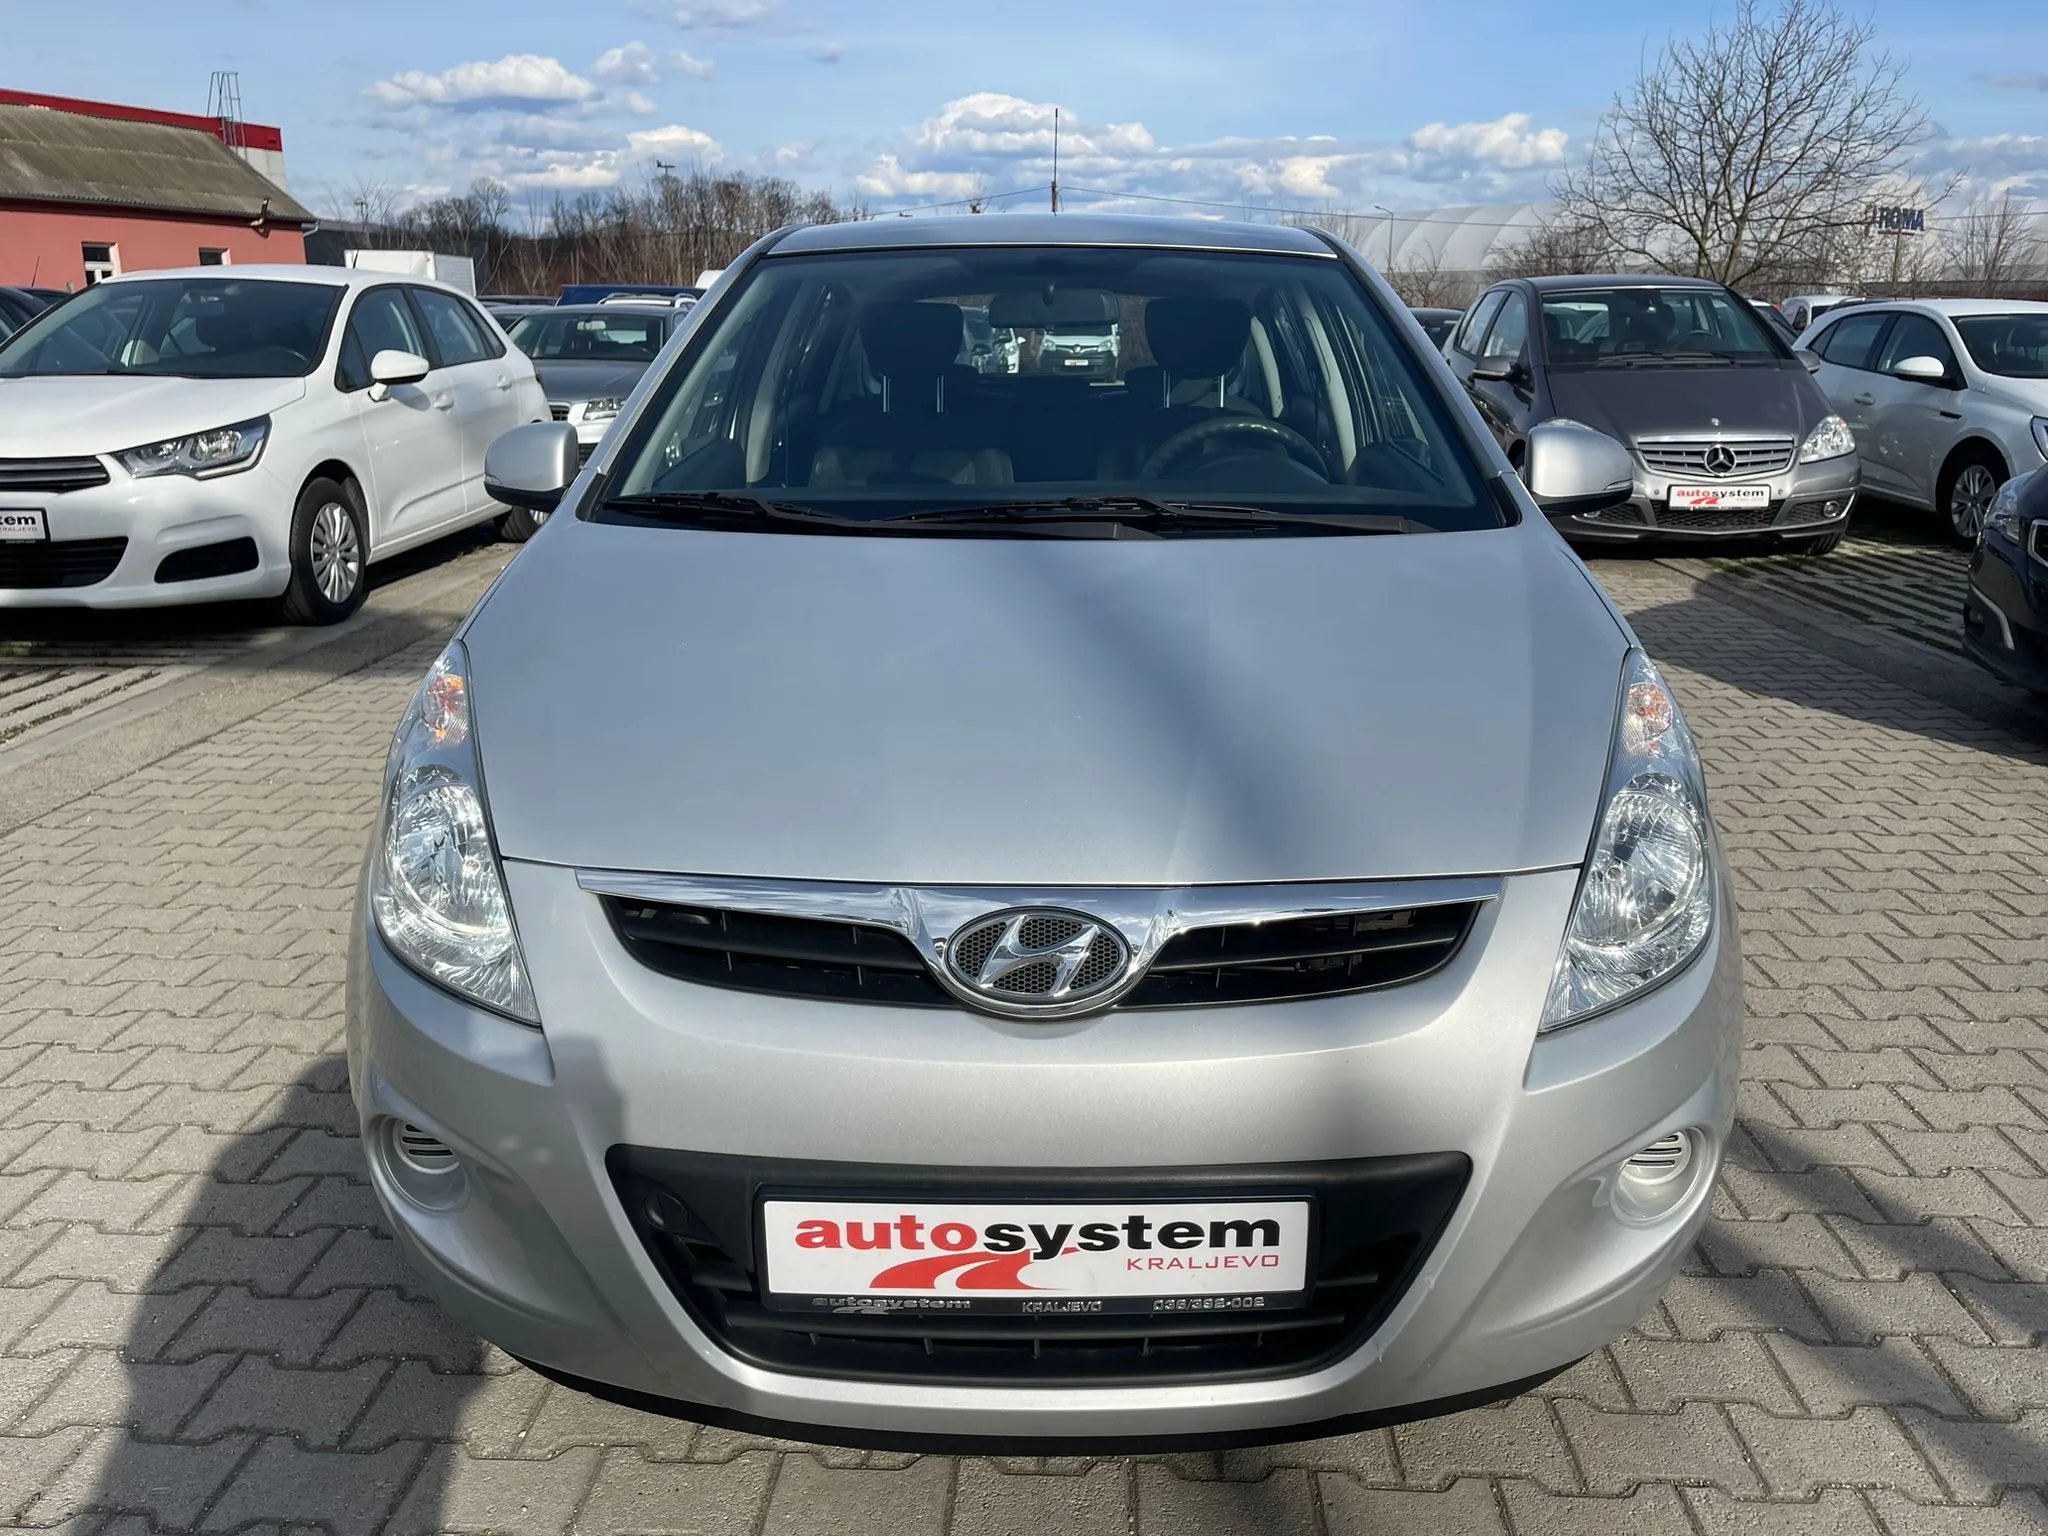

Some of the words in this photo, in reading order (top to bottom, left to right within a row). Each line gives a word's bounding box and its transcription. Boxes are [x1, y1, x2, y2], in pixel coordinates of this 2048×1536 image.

[1676, 488, 1765, 498] autosystem
[795, 1214, 1280, 1260] autosystem
[1127, 1254, 1279, 1271] KRALJEVO
[811, 1296, 971, 1310] autosystem
[1022, 1300, 1102, 1313] KRALJEVO
